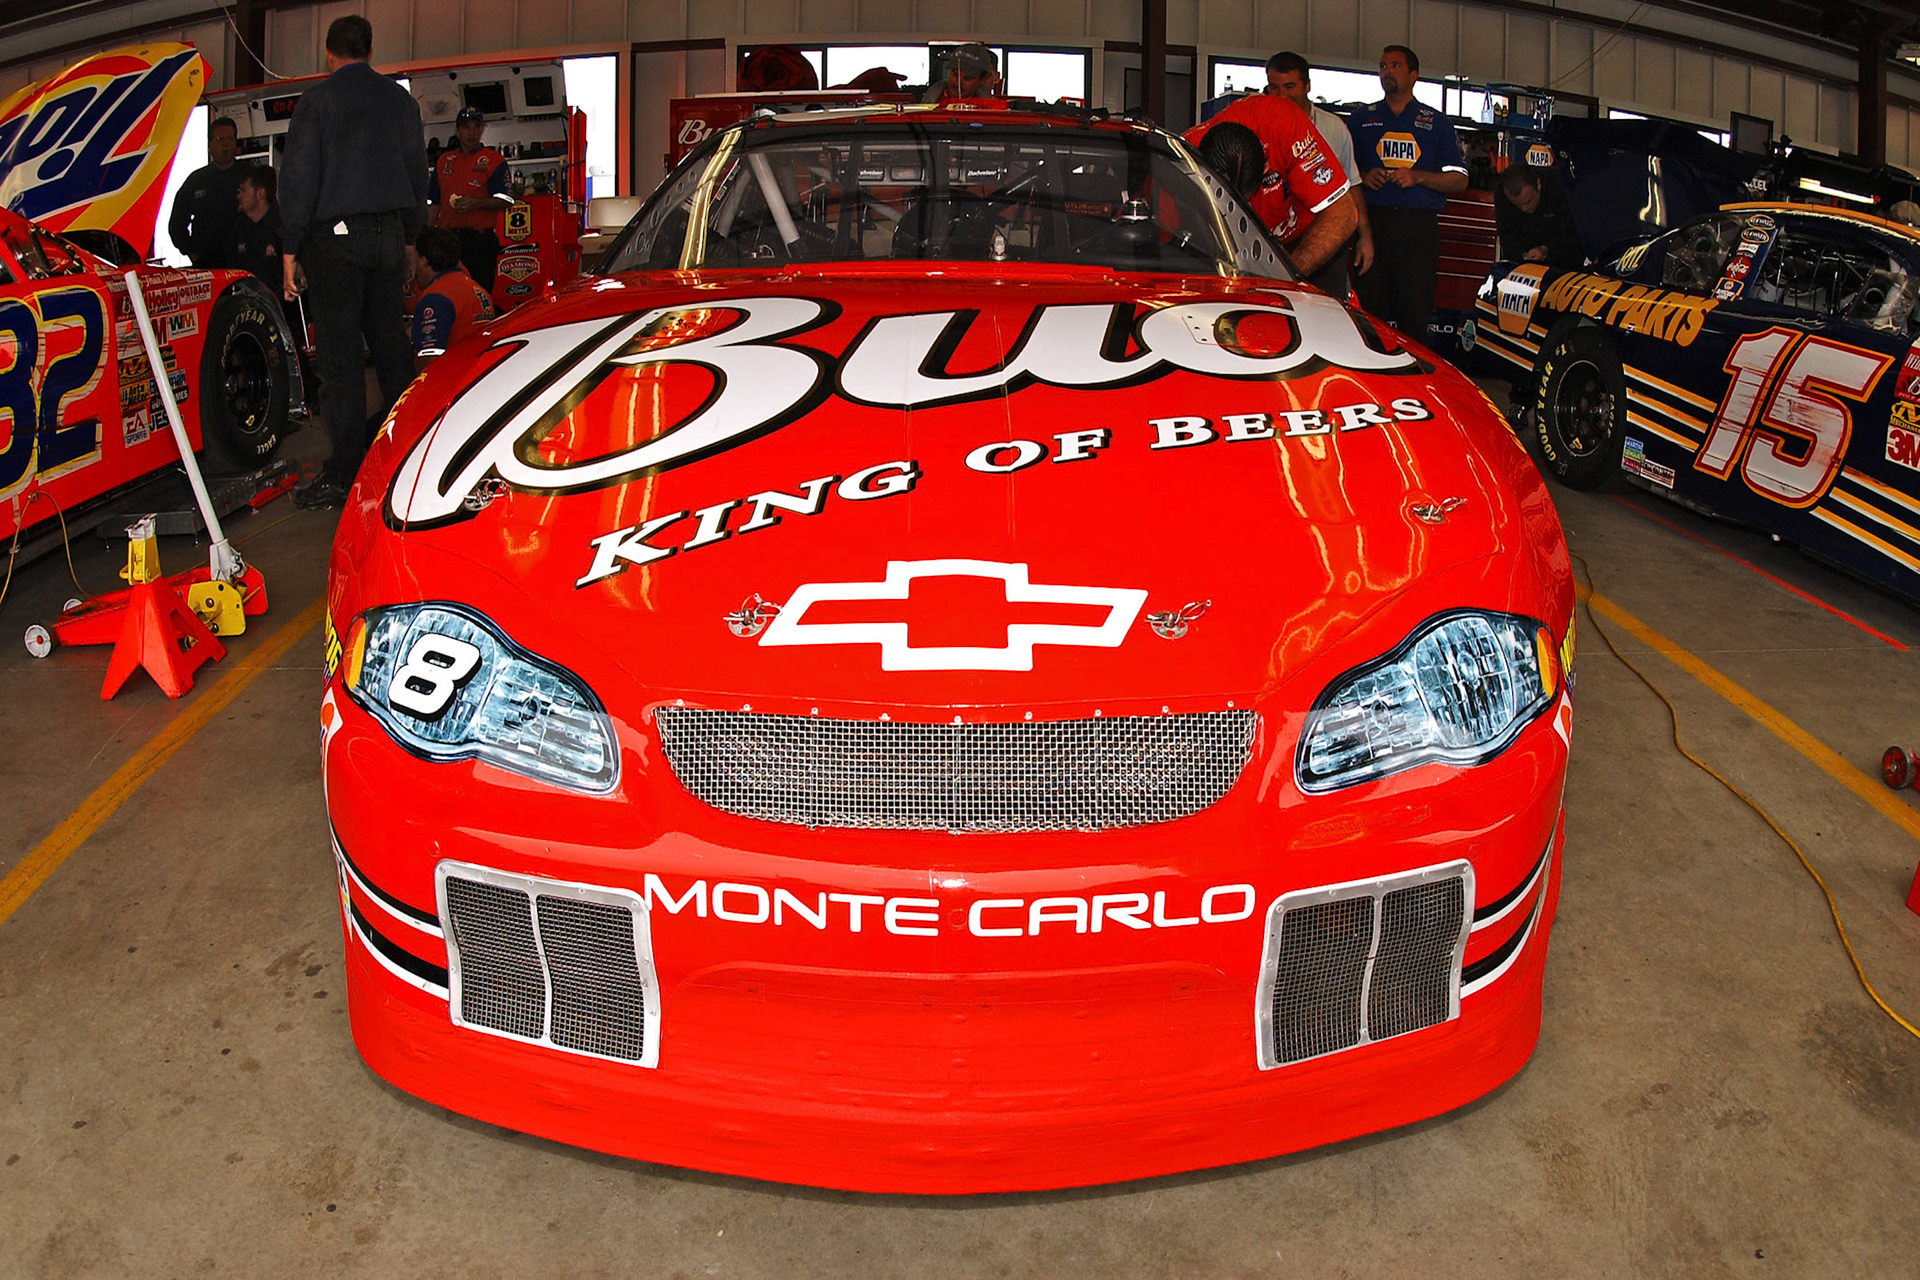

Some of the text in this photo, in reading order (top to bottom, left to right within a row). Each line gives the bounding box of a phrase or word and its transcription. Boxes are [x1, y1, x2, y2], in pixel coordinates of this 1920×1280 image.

[1291, 129, 1315, 158] Bud
[1383, 140, 1415, 160] NAPA
[1530, 150, 1549, 166] NAPA
[507, 226, 530, 235] MOTEL
[510, 212, 526, 228] 8
[501, 261, 538, 271] DIAMOND
[147, 286, 179, 310] Holley
[180, 281, 211, 298] OUTBACK
[1540, 271, 1719, 347] AUTO PARTS
[169, 312, 196, 332] WM
[1426, 323, 1454, 333] RLO
[385, 288, 1430, 531] Bud
[1537, 361, 1557, 462] GOODYEAR
[1694, 326, 1895, 508] 15
[126, 430, 148, 444] SPORTS
[256, 433, 278, 455] EAGLE
[576, 460, 919, 588] KING
[965, 427, 1109, 475] OF
[1148, 398, 1433, 451] BEERS
[388, 632, 482, 723] 8
[644, 873, 1256, 937] MONTE CARLO
